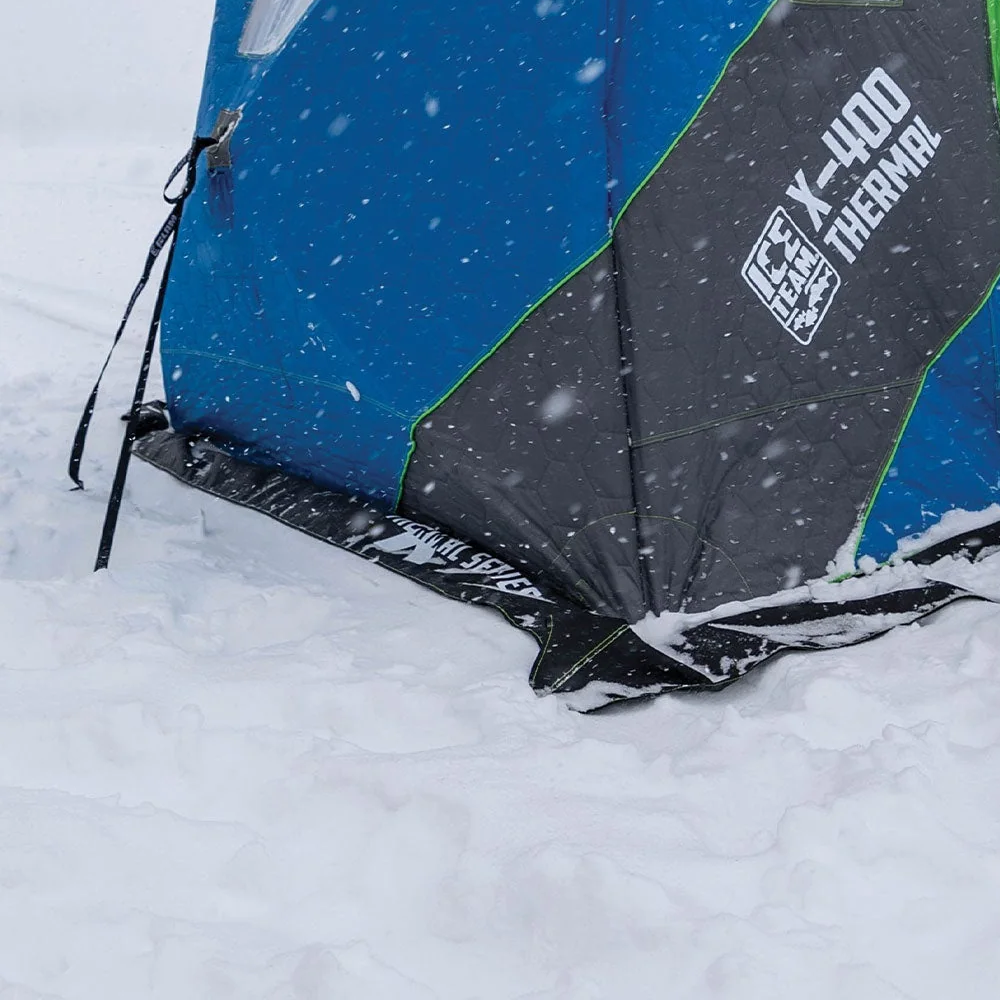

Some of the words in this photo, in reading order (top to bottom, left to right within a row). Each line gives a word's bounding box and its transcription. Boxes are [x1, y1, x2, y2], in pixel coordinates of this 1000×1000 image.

[786, 67, 911, 232] X-400
[823, 114, 942, 264] THERMAL
[747, 217, 802, 302] ICE
[771, 245, 818, 319] TEAM
